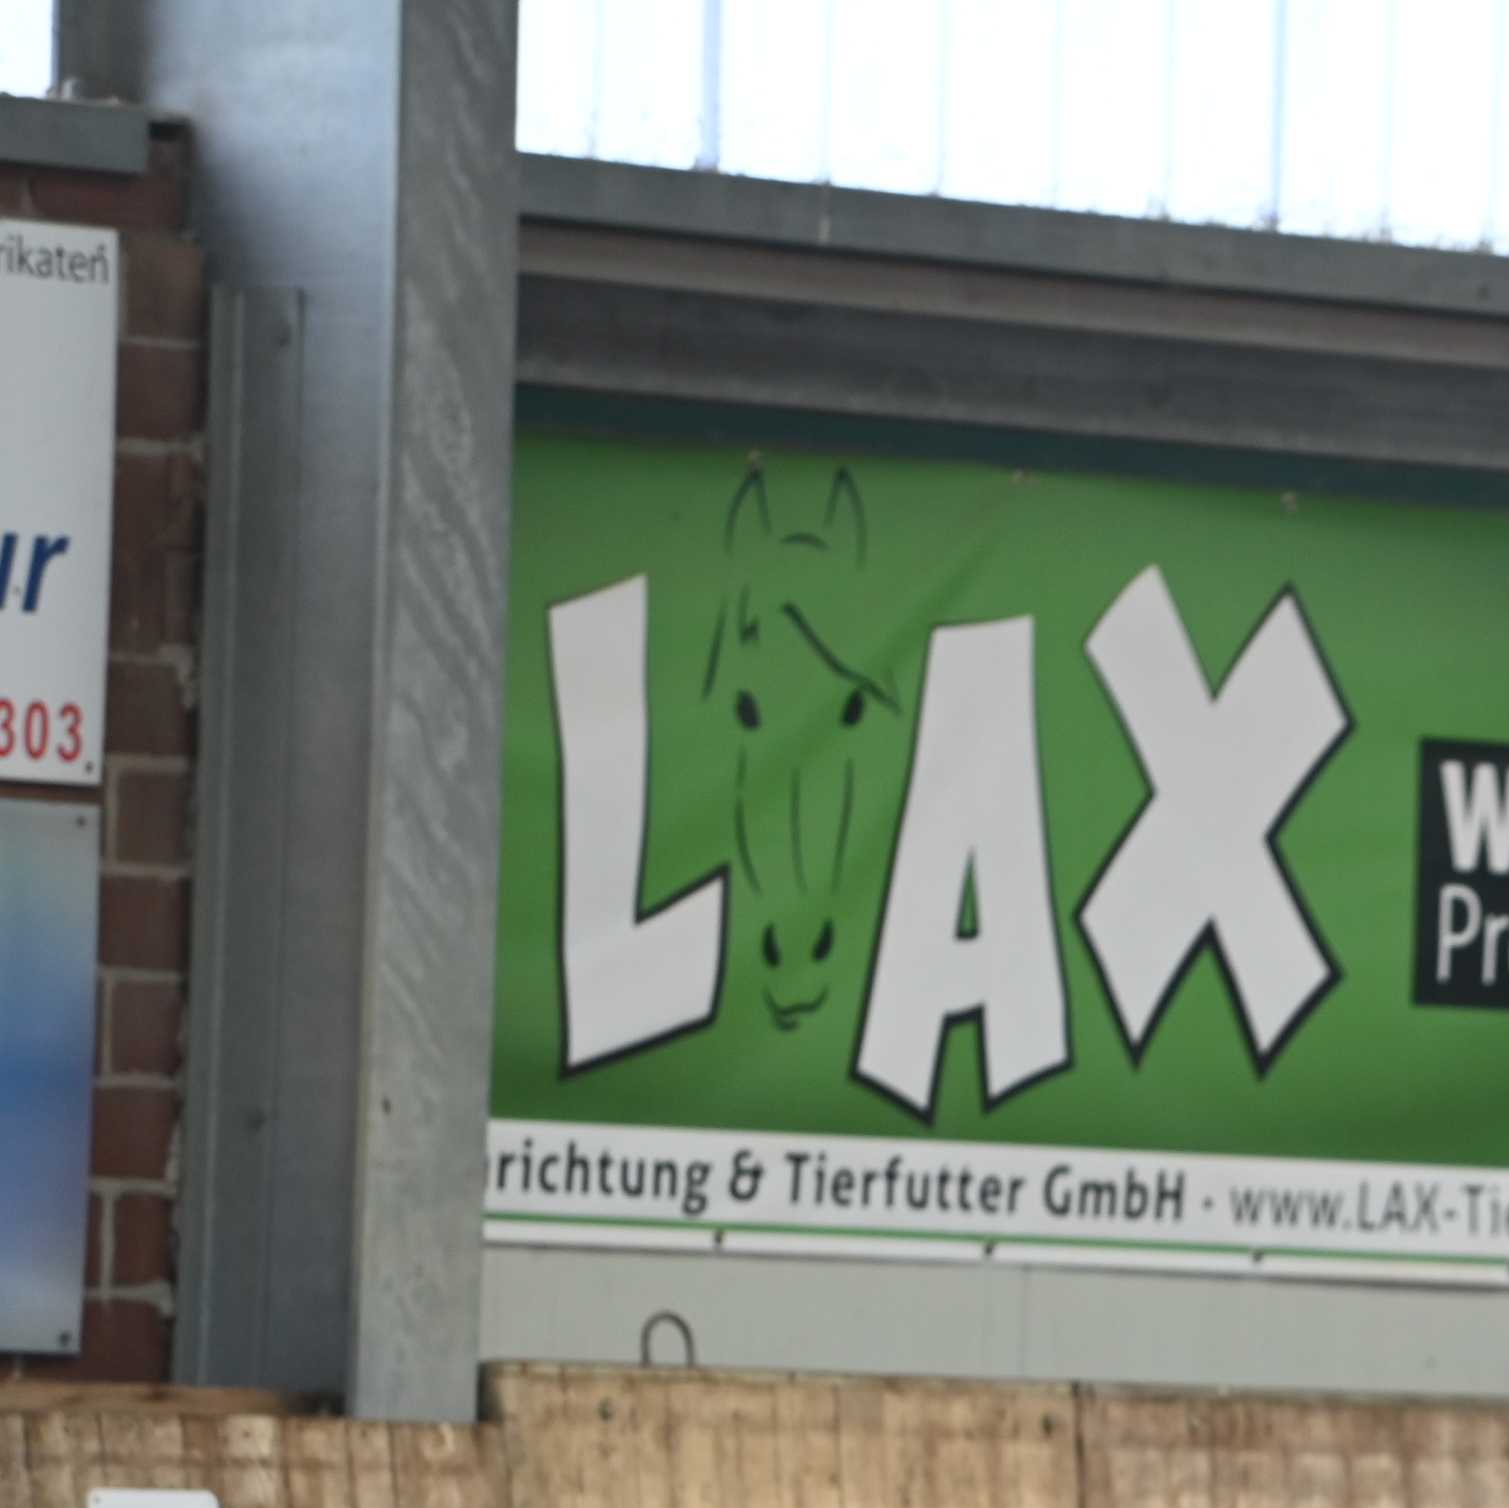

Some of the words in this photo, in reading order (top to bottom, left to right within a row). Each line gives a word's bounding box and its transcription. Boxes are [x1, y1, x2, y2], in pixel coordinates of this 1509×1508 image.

[546, 562, 1358, 1128] LAX
[482, 1138, 713, 1217] richtung
[728, 1148, 764, 1203] &
[784, 1151, 1024, 1216] Tierfutter
[1043, 1163, 1187, 1222] GmbH
